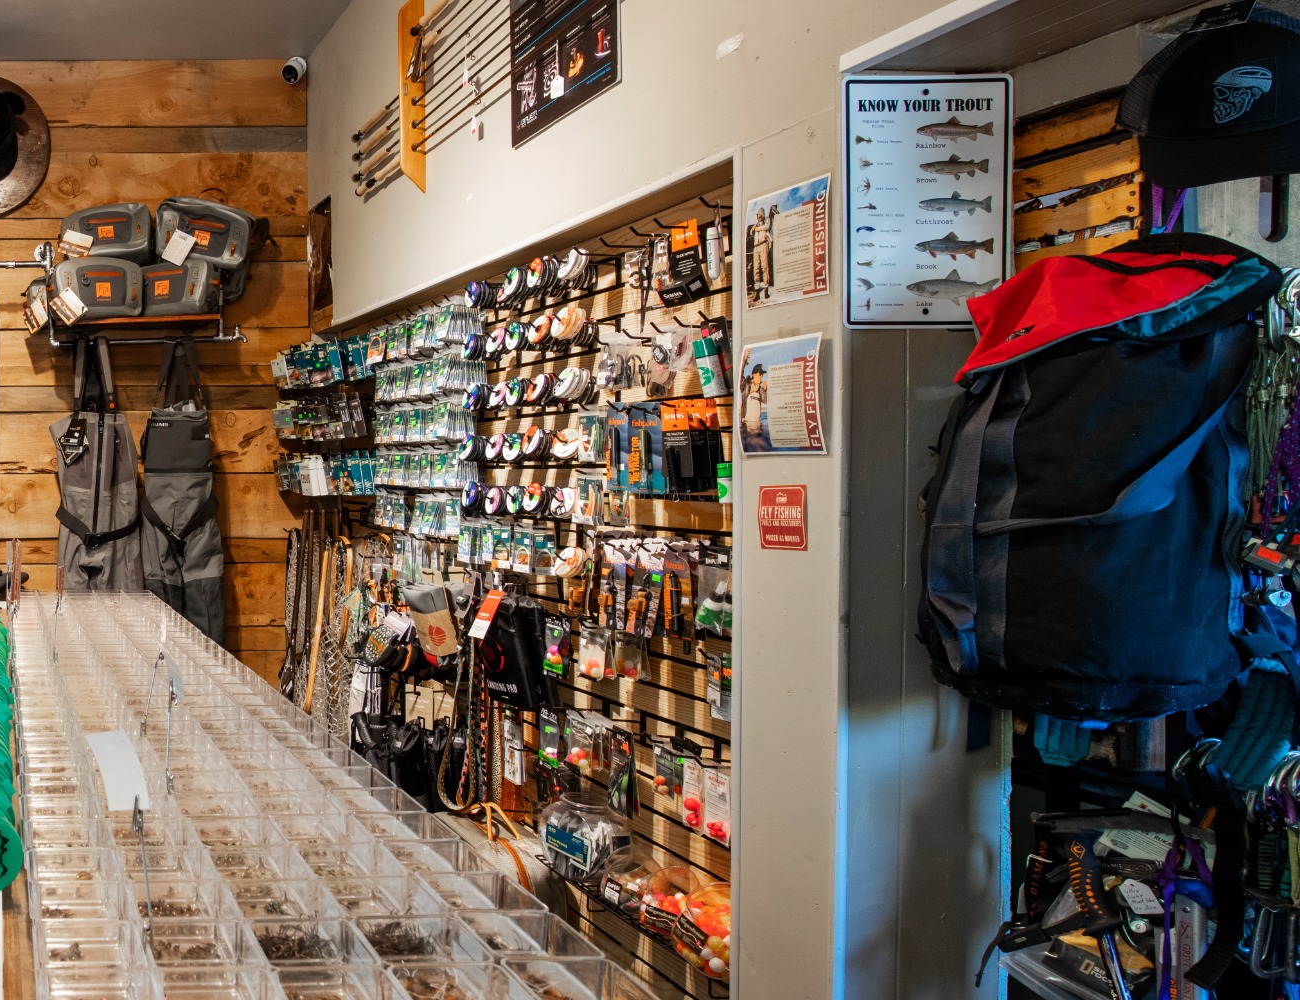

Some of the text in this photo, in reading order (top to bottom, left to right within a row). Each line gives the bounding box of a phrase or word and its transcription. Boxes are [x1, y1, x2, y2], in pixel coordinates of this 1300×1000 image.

[858, 98, 993, 112] KNOW YOUR TROUT
[675, 231, 693, 240] SIMMS
[815, 190, 826, 289] FLY FISHING
[806, 350, 821, 447] FLY FISHING
[632, 419, 658, 428] fishpond
[632, 437, 640, 482] RETRACTOR
[761, 507, 801, 519] FLY FISHING
[486, 679, 518, 693] LANDING PAD
